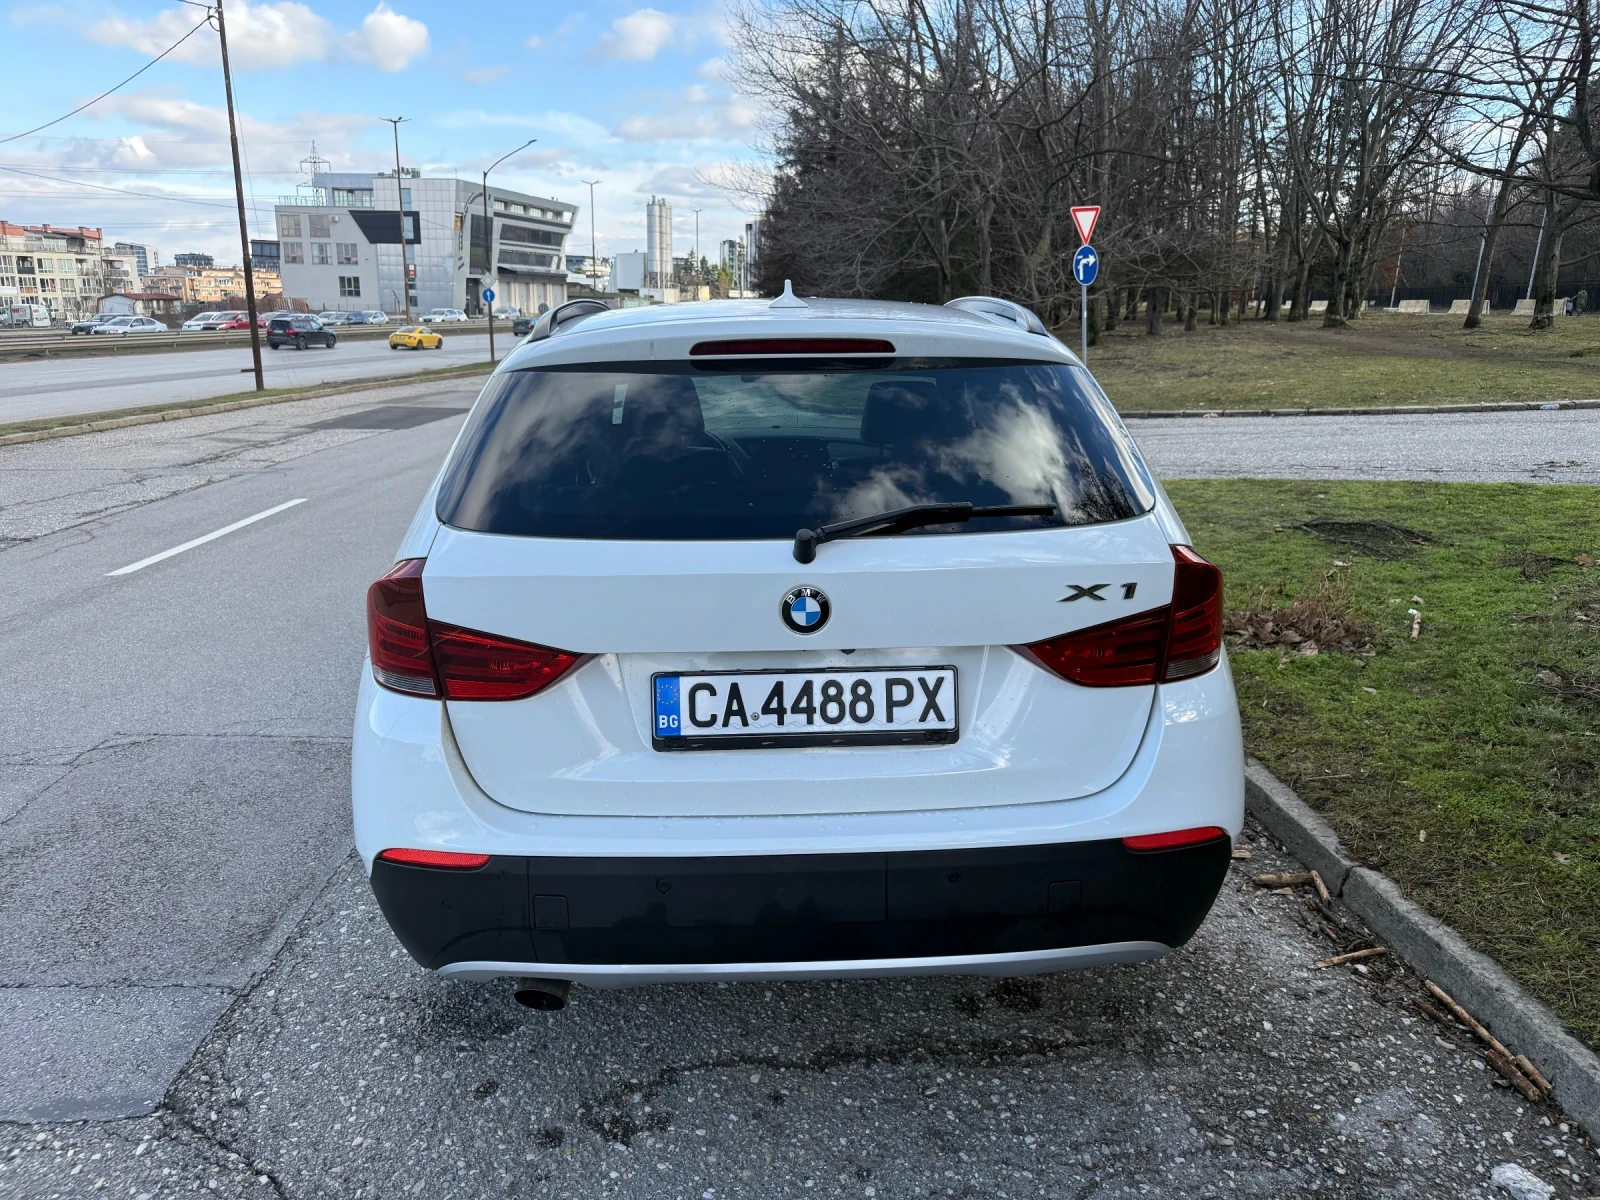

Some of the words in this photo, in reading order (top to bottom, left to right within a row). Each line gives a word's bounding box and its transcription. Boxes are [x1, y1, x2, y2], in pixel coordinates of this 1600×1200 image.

[785, 588, 827, 605] BMW
[1056, 582, 1138, 603] X1
[688, 682, 749, 728] CA
[761, 678, 875, 726] 4488
[885, 676, 947, 724] PX
[658, 714, 679, 729] BG
